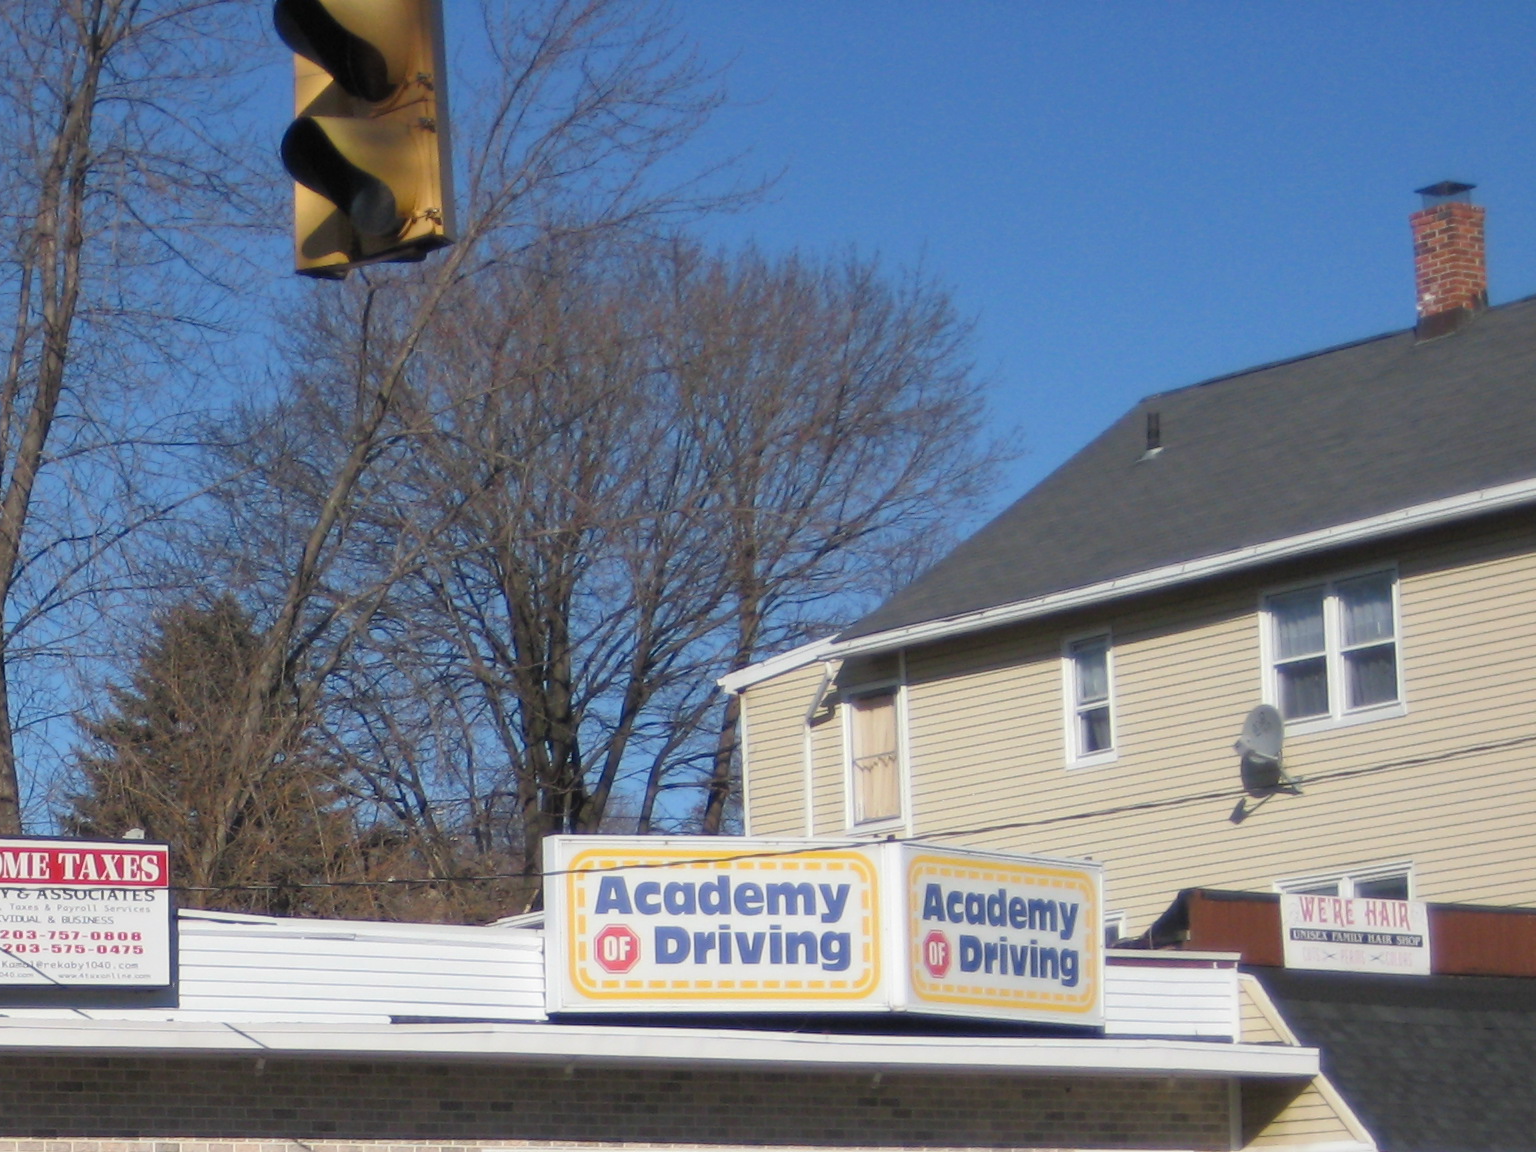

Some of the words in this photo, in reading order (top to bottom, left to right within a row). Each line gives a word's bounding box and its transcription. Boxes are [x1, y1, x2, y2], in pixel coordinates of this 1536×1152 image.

[58, 853, 160, 882] TAXES
[17, 887, 30, 900] &
[37, 888, 156, 902] ASSOCIATES
[594, 875, 851, 923] Academy
[10, 903, 40, 911] Taxes
[57, 905, 98, 914] Payroll
[105, 905, 151, 913] Services
[923, 883, 1079, 940] Academy
[1300, 896, 1355, 927] WE'RE
[1365, 900, 1411, 931] HAIR
[48, 916, 56, 924] &
[61, 916, 115, 925] BUSINESS
[0, 929, 142, 941] 203-757-0808
[1293, 929, 1327, 941] UNISEX
[1332, 932, 1364, 943] FAMILY
[1368, 934, 1393, 945] HAIR
[1396, 936, 1422, 946] SHOP
[2, 943, 144, 955] 203-575-0475
[603, 935, 632, 962] OF
[654, 924, 851, 972] Driving
[928, 941, 947, 966] OF
[959, 934, 1079, 987] Driving
